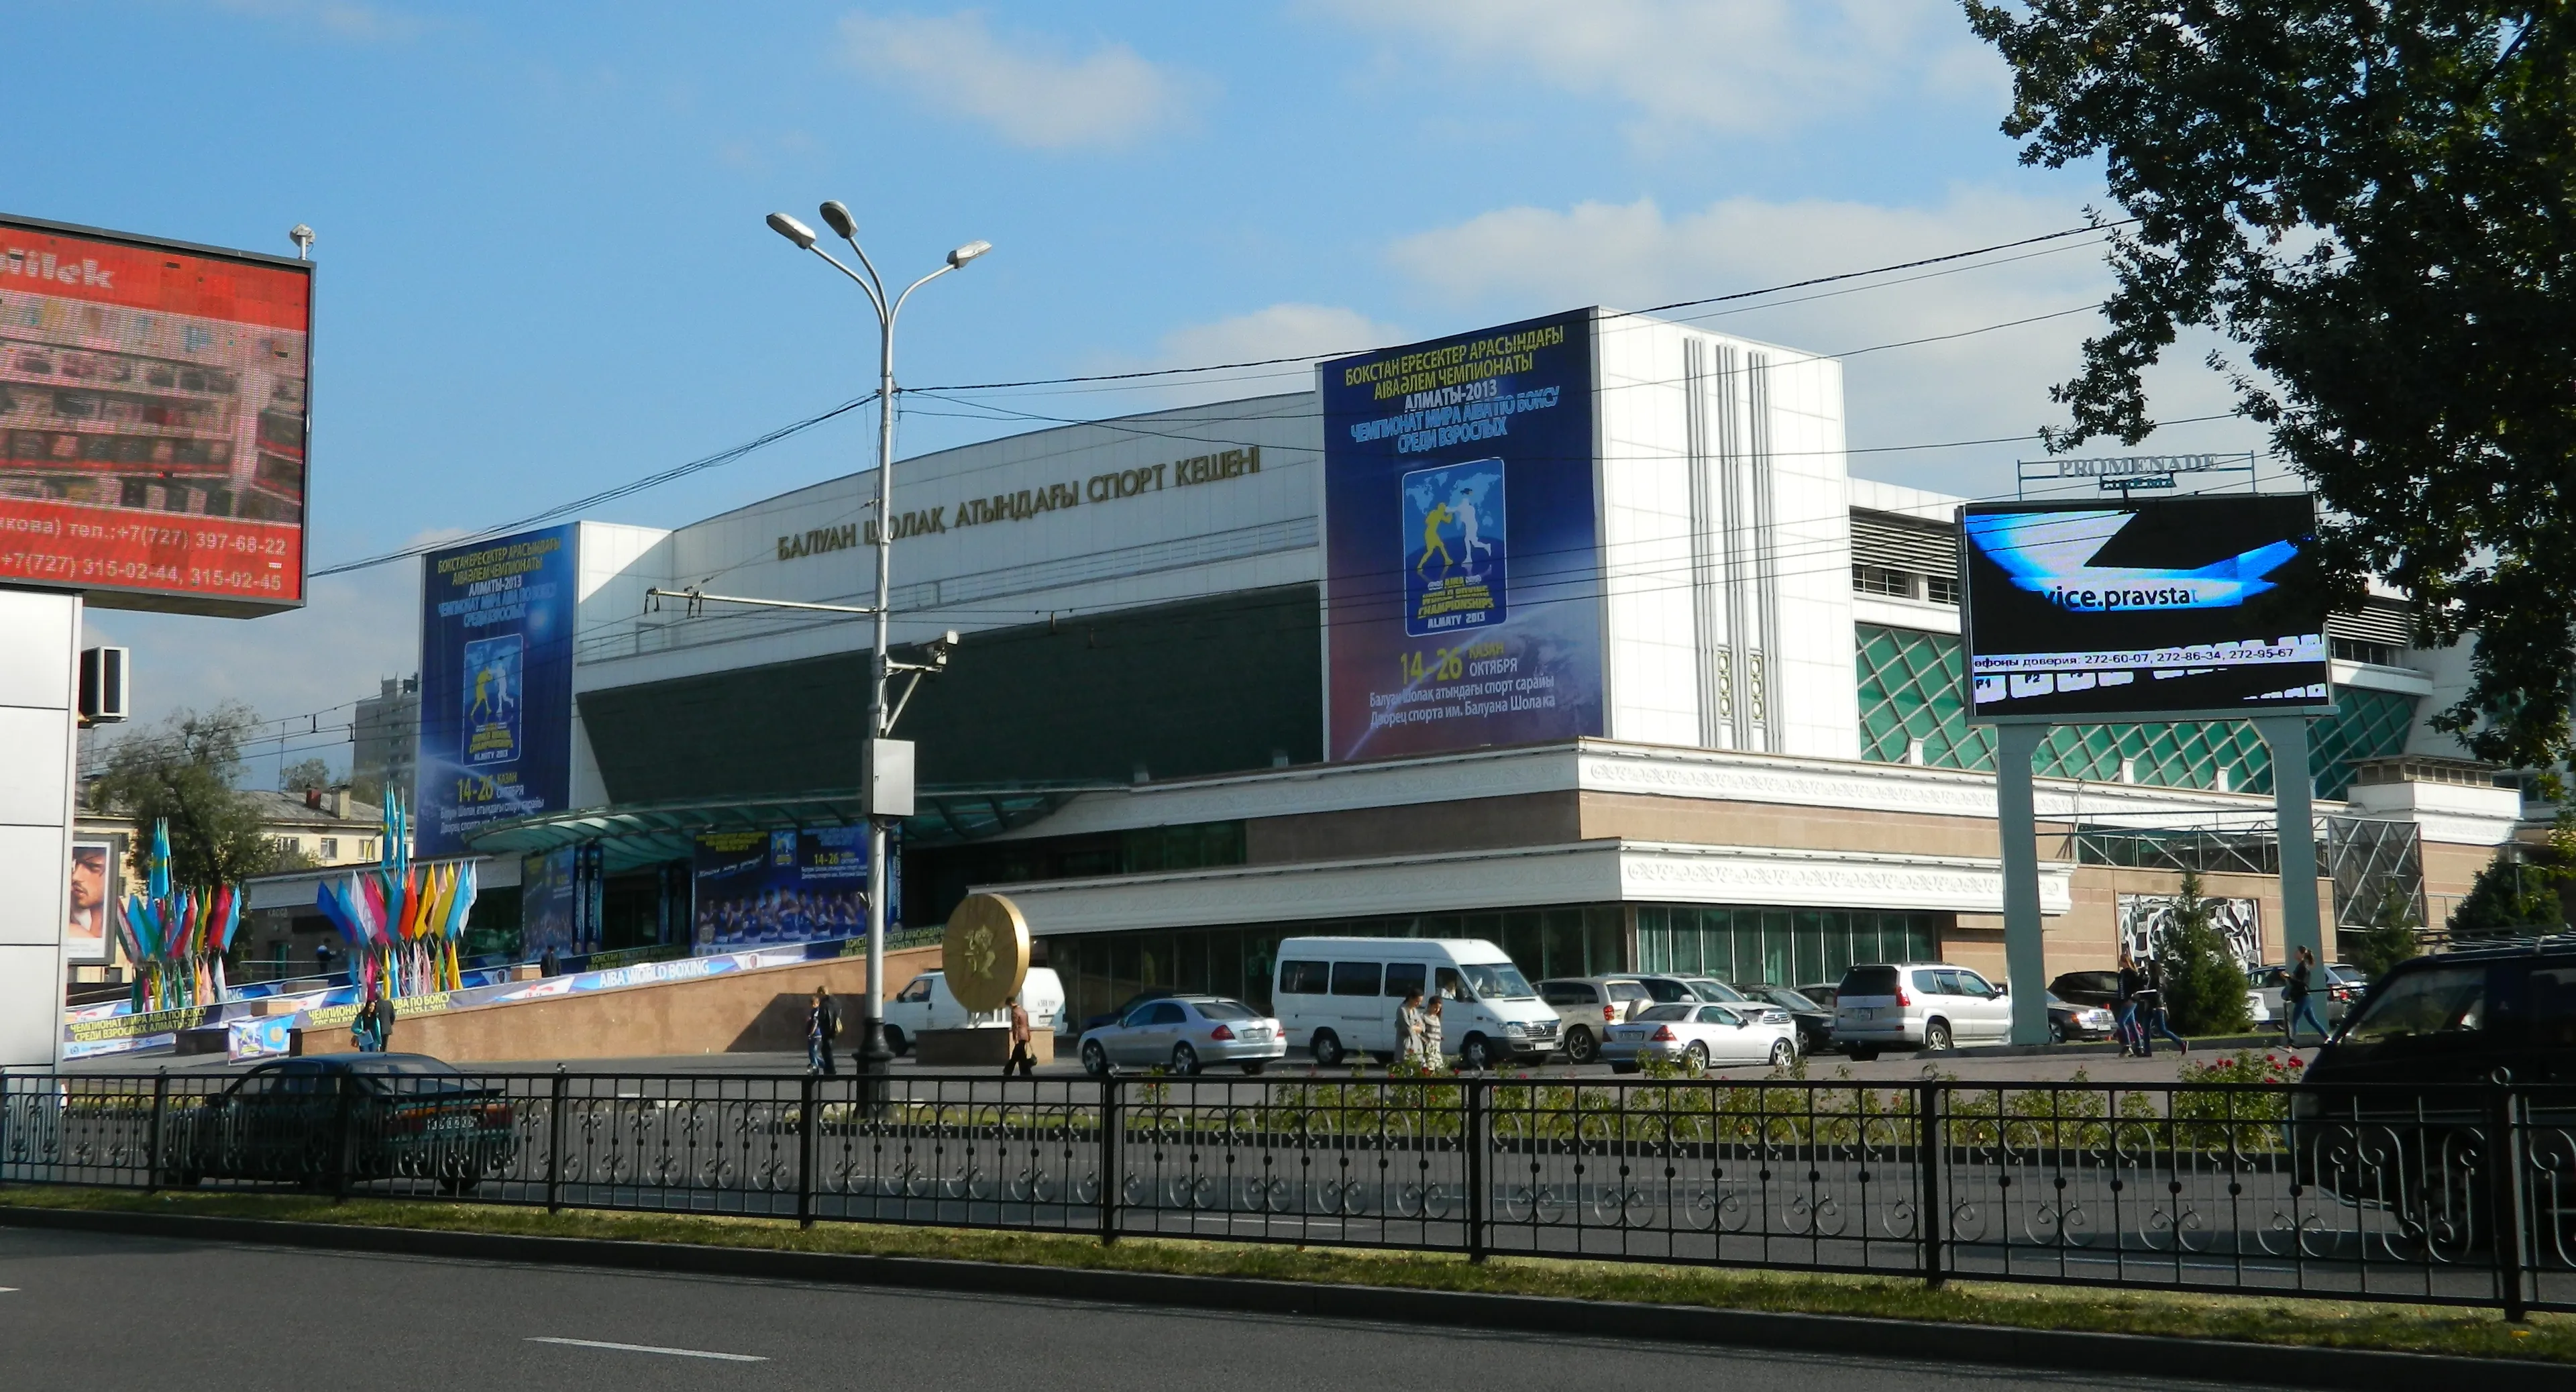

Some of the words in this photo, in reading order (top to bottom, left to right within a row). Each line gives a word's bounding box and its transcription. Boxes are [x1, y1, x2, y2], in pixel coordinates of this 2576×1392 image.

[1345, 358, 1399, 386] БОКСТАН
[1401, 344, 1467, 374] ЕРЕСЕКТЕР
[1469, 325, 1564, 360] АРАСЫНДАҒЫ
[1438, 352, 1533, 386] ЧЕМПИОНАТЫ
[1404, 378, 1497, 413] АЛМАТЫ-2013
[1351, 411, 1424, 443] ЧЕМПИОНАТ
[1425, 405, 1462, 429] МИРА
[1516, 385, 1560, 413] БОКСУ
[1397, 429, 1437, 454] СРЕДИ
[1438, 416, 1508, 447] ВЗРОСЛЫХ
[2058, 453, 2219, 478] PROMENADE
[777, 523, 857, 561] БАЛУАН
[954, 480, 1079, 529] АТЫНДАҒЫ
[1086, 463, 1167, 503] СПОРТ
[1427, 614, 1462, 629] ALMATY
[1465, 611, 1486, 624] 2013
[1400, 647, 1463, 685] 14-26
[1469, 657, 1518, 678] ОКТЯБРЯ
[2022, 657, 2080, 668] доверия:
[2084, 653, 2153, 665] 272-60-07,
[2156, 651, 2225, 661] 272-86-34,
[2229, 648, 2294, 659] 272-95-67
[1435, 683, 1483, 700] атындағы
[1485, 679, 1514, 696] спорт
[1515, 671, 1555, 694] сарайы
[1370, 710, 1407, 729] Дворец
[1407, 707, 1444, 725] спорта
[1445, 705, 1463, 718] им.
[1464, 700, 1509, 718] Балуана
[1509, 694, 1556, 711] Шолака
[599, 971, 625, 988] AIBA
[627, 965, 667, 985] WORLD
[667, 959, 709, 980] BOXING
[308, 1004, 362, 1021] ЧЕМПИОНАТ
[411, 996, 423, 1007] ПО
[424, 993, 451, 1006] БОКСУ
[70, 1017, 121, 1033] ЧЕМПИОНАТ
[123, 1015, 147, 1026] МИРА
[74, 1030, 102, 1042] СРЕДИ
